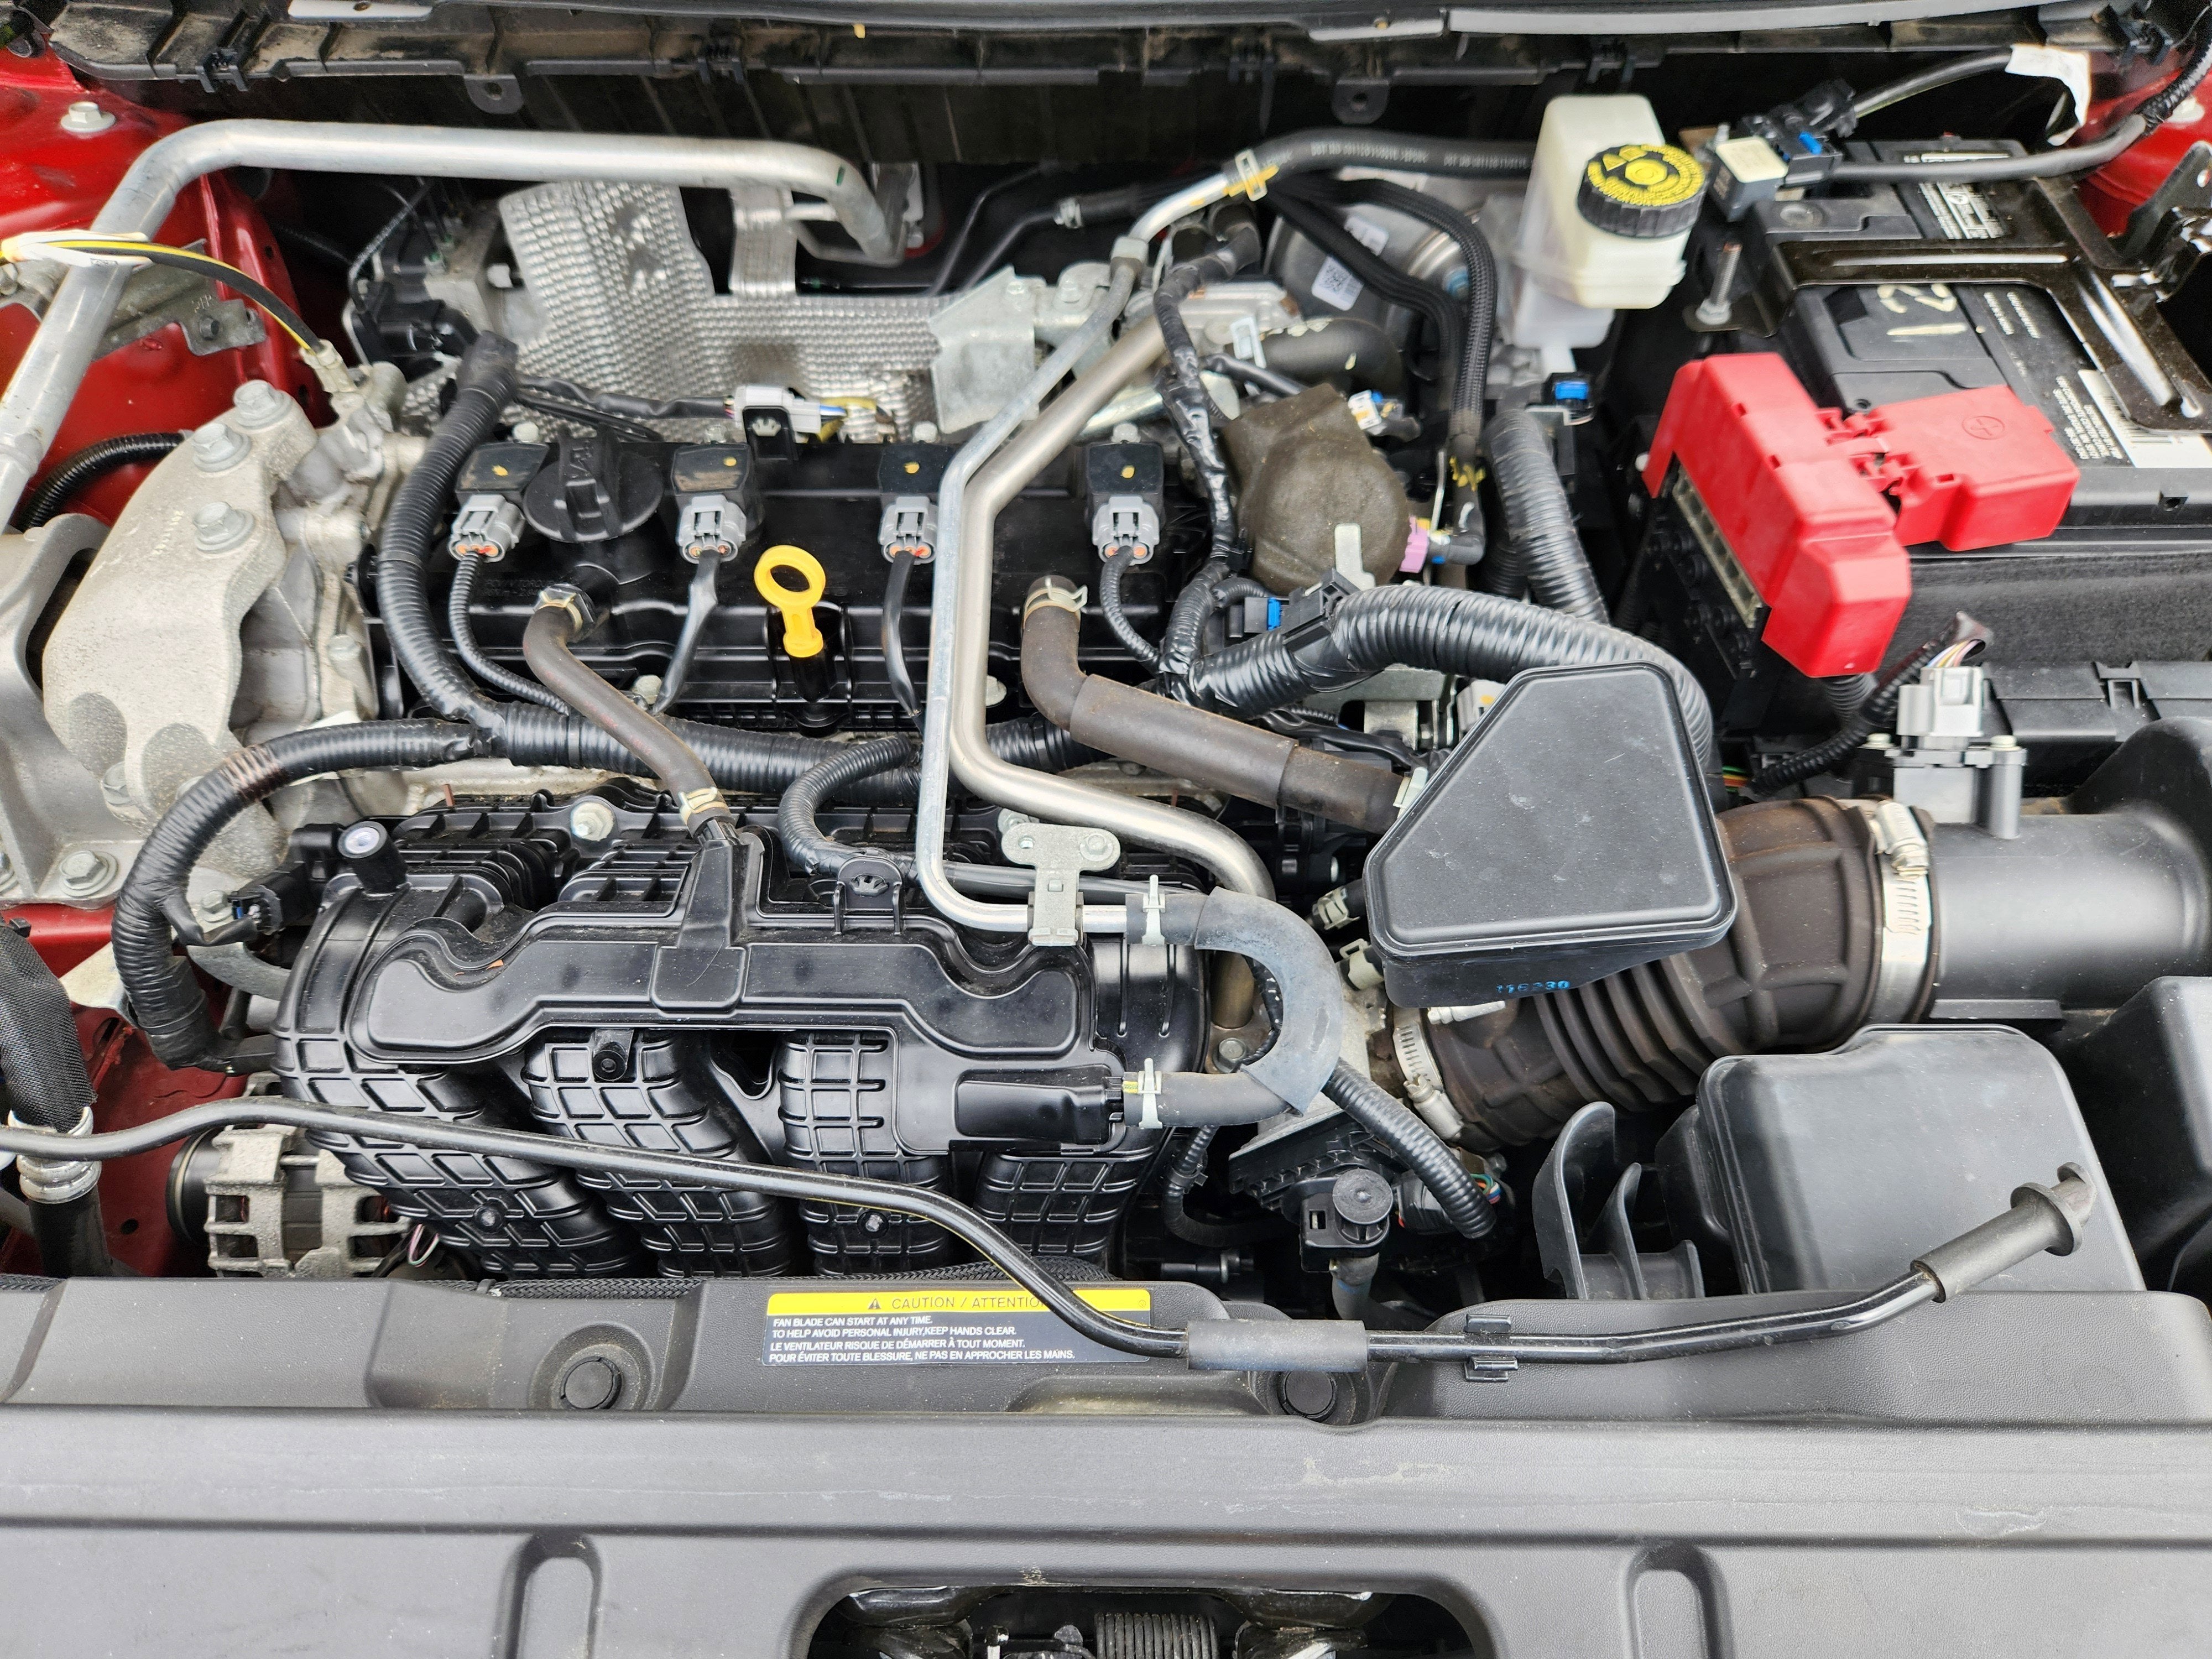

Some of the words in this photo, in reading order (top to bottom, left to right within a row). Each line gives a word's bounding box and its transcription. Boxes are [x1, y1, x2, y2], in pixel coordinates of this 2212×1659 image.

[891, 1297, 954, 1310] CAUTION
[960, 1297, 967, 1308] /
[972, 1297, 1045, 1308] ATTENTIO
[774, 1318, 791, 1327] FAN
[793, 1318, 823, 1327] BLADE
[824, 1317, 845, 1326] CAN
[847, 1317, 875, 1326] START
[876, 1317, 888, 1325] AT
[889, 1316, 909, 1325] ANY
[911, 1316, 933, 1324] TIME.
[772, 1329, 785, 1338] TO
[786, 1329, 811, 1338] HELP
[811, 1328, 840, 1338] AVOID
[842, 1328, 892, 1338] PERSONAL
[950, 1327, 983, 1335] HANDS
[984, 1327, 1017, 1335] CLEAR.
[770, 1342, 782, 1352] LE
[784, 1341, 843, 1351] VENTILATEUR
[844, 1340, 880, 1350] RISQUE
[881, 1340, 895, 1349] DE
[896, 1338, 947, 1350] DÉMARRER
[948, 1337, 956, 1348] À
[957, 1339, 982, 1348] TOUT
[983, 1339, 1025, 1348] MOMENT.
[769, 1354, 797, 1363] POUR
[797, 1351, 830, 1363] ÉVITER
[831, 1353, 862, 1362] TOUTE
[862, 1352, 913, 1362] BLESSURE,
[914, 1351, 928, 1360] NE
[930, 1351, 948, 1359] PAS
[950, 1351, 963, 1359] EN
[964, 1350, 1023, 1360] APPROCHER
[1024, 1350, 1042, 1359] LES
[1044, 1350, 1076, 1359] MAINS.
